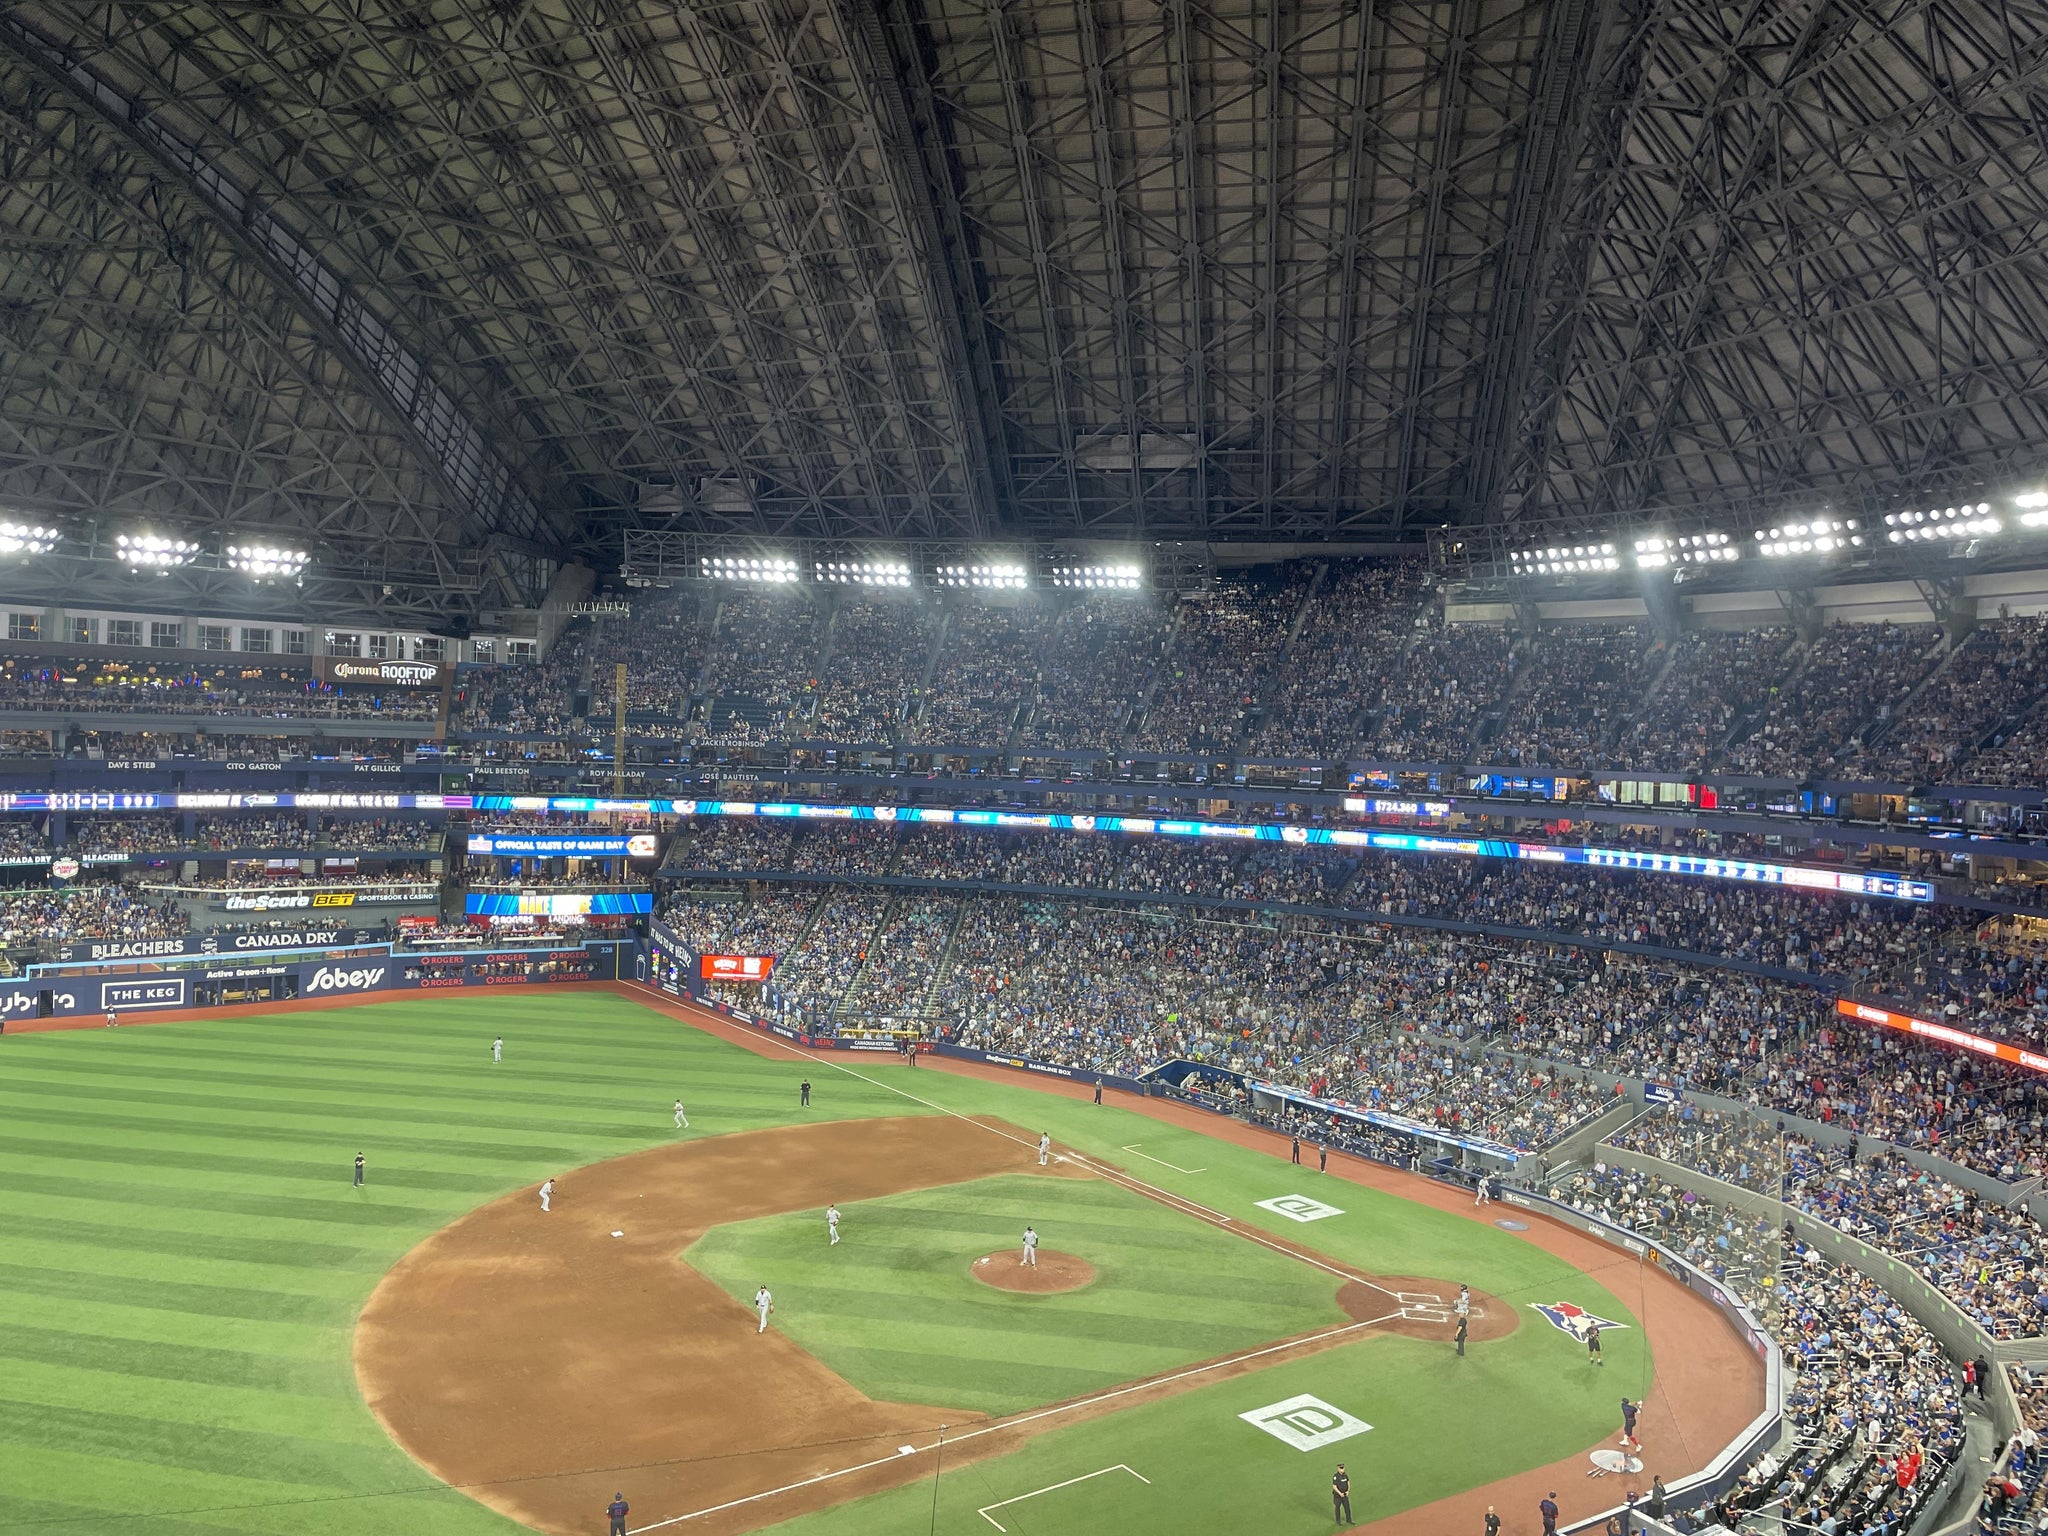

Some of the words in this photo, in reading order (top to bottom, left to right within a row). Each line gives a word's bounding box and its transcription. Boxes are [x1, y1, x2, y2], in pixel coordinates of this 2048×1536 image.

[334, 663, 379, 678] Corona
[381, 666, 436, 679] ROOFTOP
[728, 740, 765, 748] ROBINSON
[371, 765, 401, 773] GILLICK
[607, 770, 646, 778] HALLADAY
[700, 772, 719, 780] JOSÉ
[495, 840, 535, 850] OFFICIAL
[535, 841, 562, 850] TASTE
[562, 841, 576, 850] OF
[577, 841, 604, 850] GAME
[605, 841, 624, 850] DAY
[82, 854, 129, 862] BLEACHERS
[225, 895, 310, 910] theScore
[315, 895, 352, 905] BET
[500, 916, 534, 924] ROGERS
[549, 915, 583, 924] LANDING
[235, 933, 303, 948] CANADA
[91, 940, 184, 958] BLEACHERS
[496, 953, 528, 962] ROGERS
[558, 951, 590, 959] ROGERS
[674, 945, 692, 969] HEINZ
[430, 956, 464, 964] ROGERS
[206, 971, 233, 979] Active
[558, 973, 589, 981] ROGERS
[306, 967, 385, 993] Sobeys
[430, 978, 463, 986] ROGERS
[495, 976, 527, 984] ROGERS
[112, 991, 141, 1000] THE
[146, 988, 175, 998] KEG
[814, 1039, 836, 1048] HEINZ
[914, 1043, 936, 1052] HEINZ
[1028, 1063, 1058, 1074] BASELINE
[1058, 1068, 1072, 1076] BOX
[1512, 1195, 1531, 1206] clover
[1272, 1199, 1321, 1218] TD
[1259, 1405, 1345, 1437] TD
